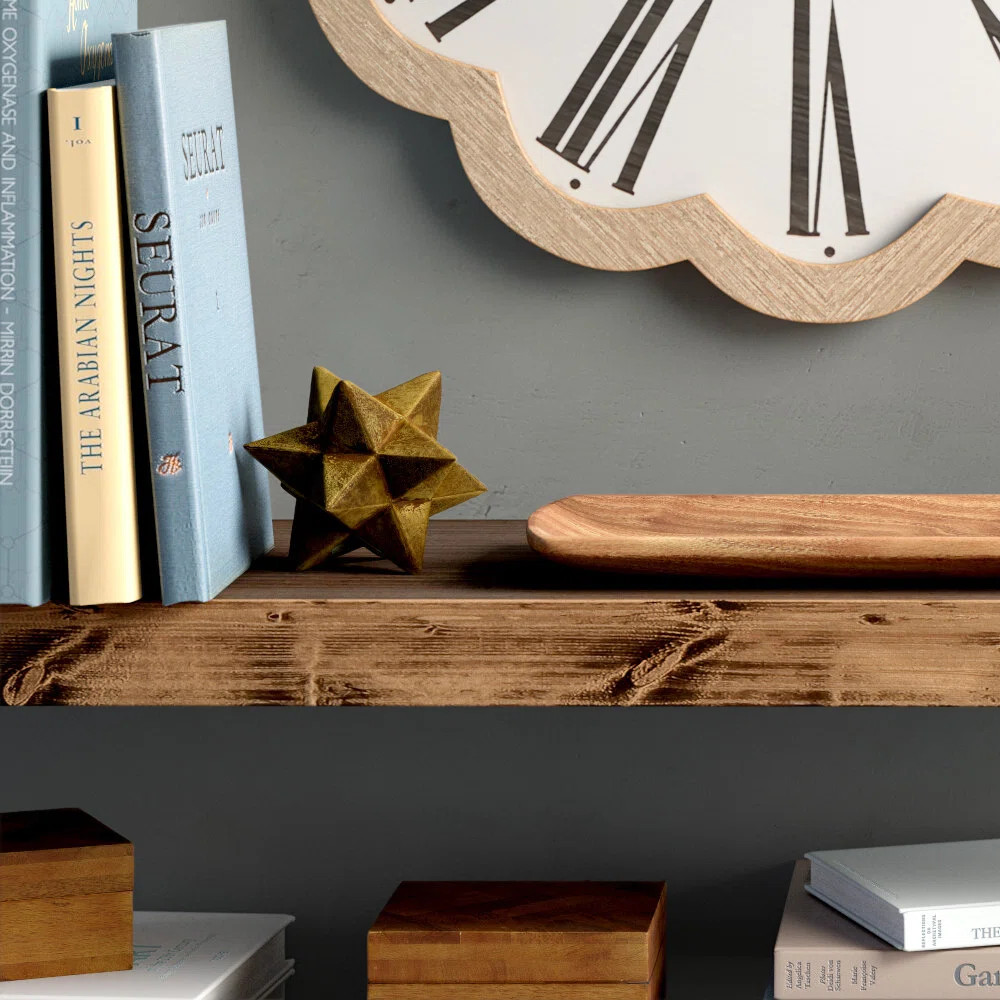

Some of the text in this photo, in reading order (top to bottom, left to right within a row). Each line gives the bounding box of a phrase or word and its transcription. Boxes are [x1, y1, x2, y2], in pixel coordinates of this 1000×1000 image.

[1, 27, 18, 126] OXYGENASE
[1, 131, 17, 171] AND
[181, 125, 225, 181] SEURAT
[0, 176, 17, 301] INFLAMMATION
[134, 212, 185, 393] SEURAT
[0, 321, 15, 377] MIRRIN
[71, 220, 103, 475] THE ARABIAN NIGHTS
[971, 925, 1000, 940] THE
